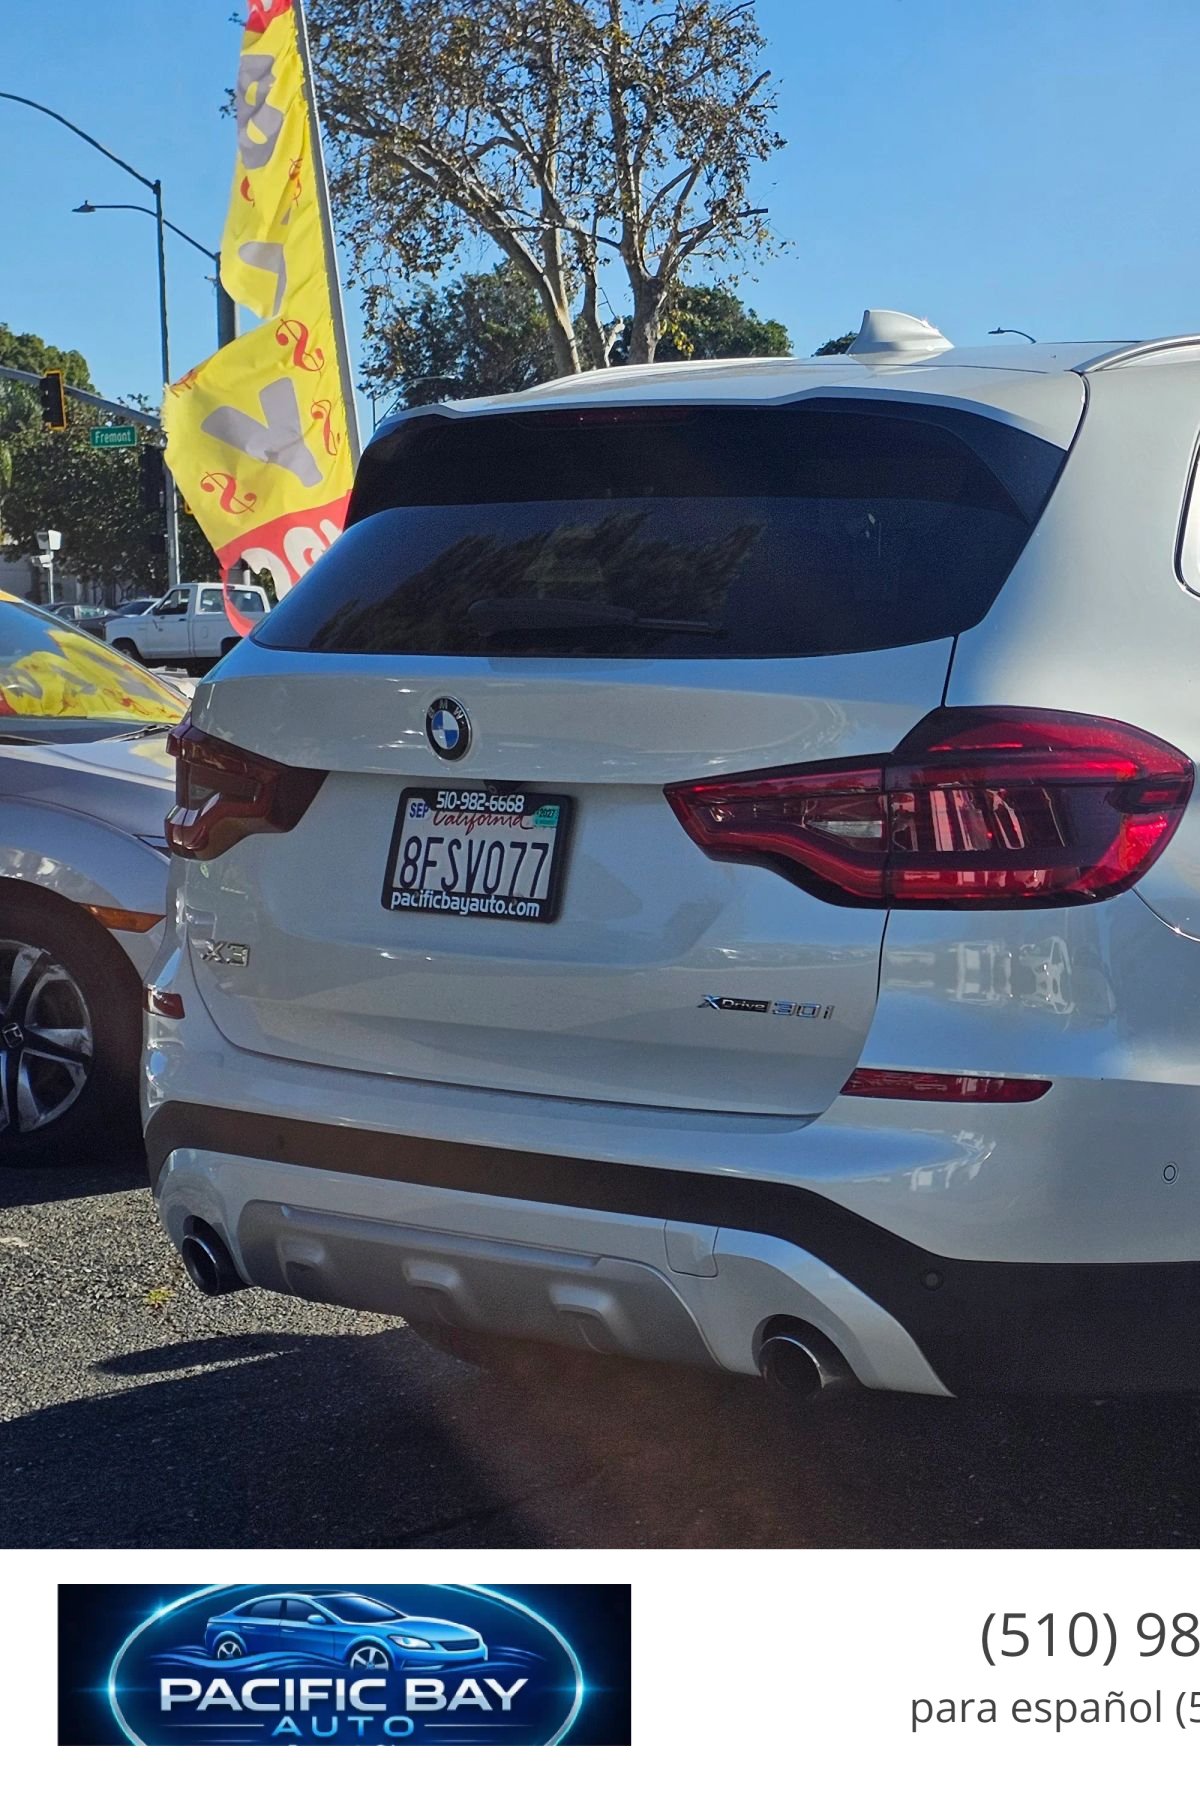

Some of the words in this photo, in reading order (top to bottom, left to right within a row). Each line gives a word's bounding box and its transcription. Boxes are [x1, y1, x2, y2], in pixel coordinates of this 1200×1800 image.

[94, 430, 132, 444] Fremont
[409, 802, 430, 819] SEP
[436, 791, 525, 813] 510-982-6668
[432, 810, 536, 836] California
[400, 835, 550, 898] 8FSV077
[391, 889, 540, 917] pacificbayauto.com
[202, 939, 250, 967] X3
